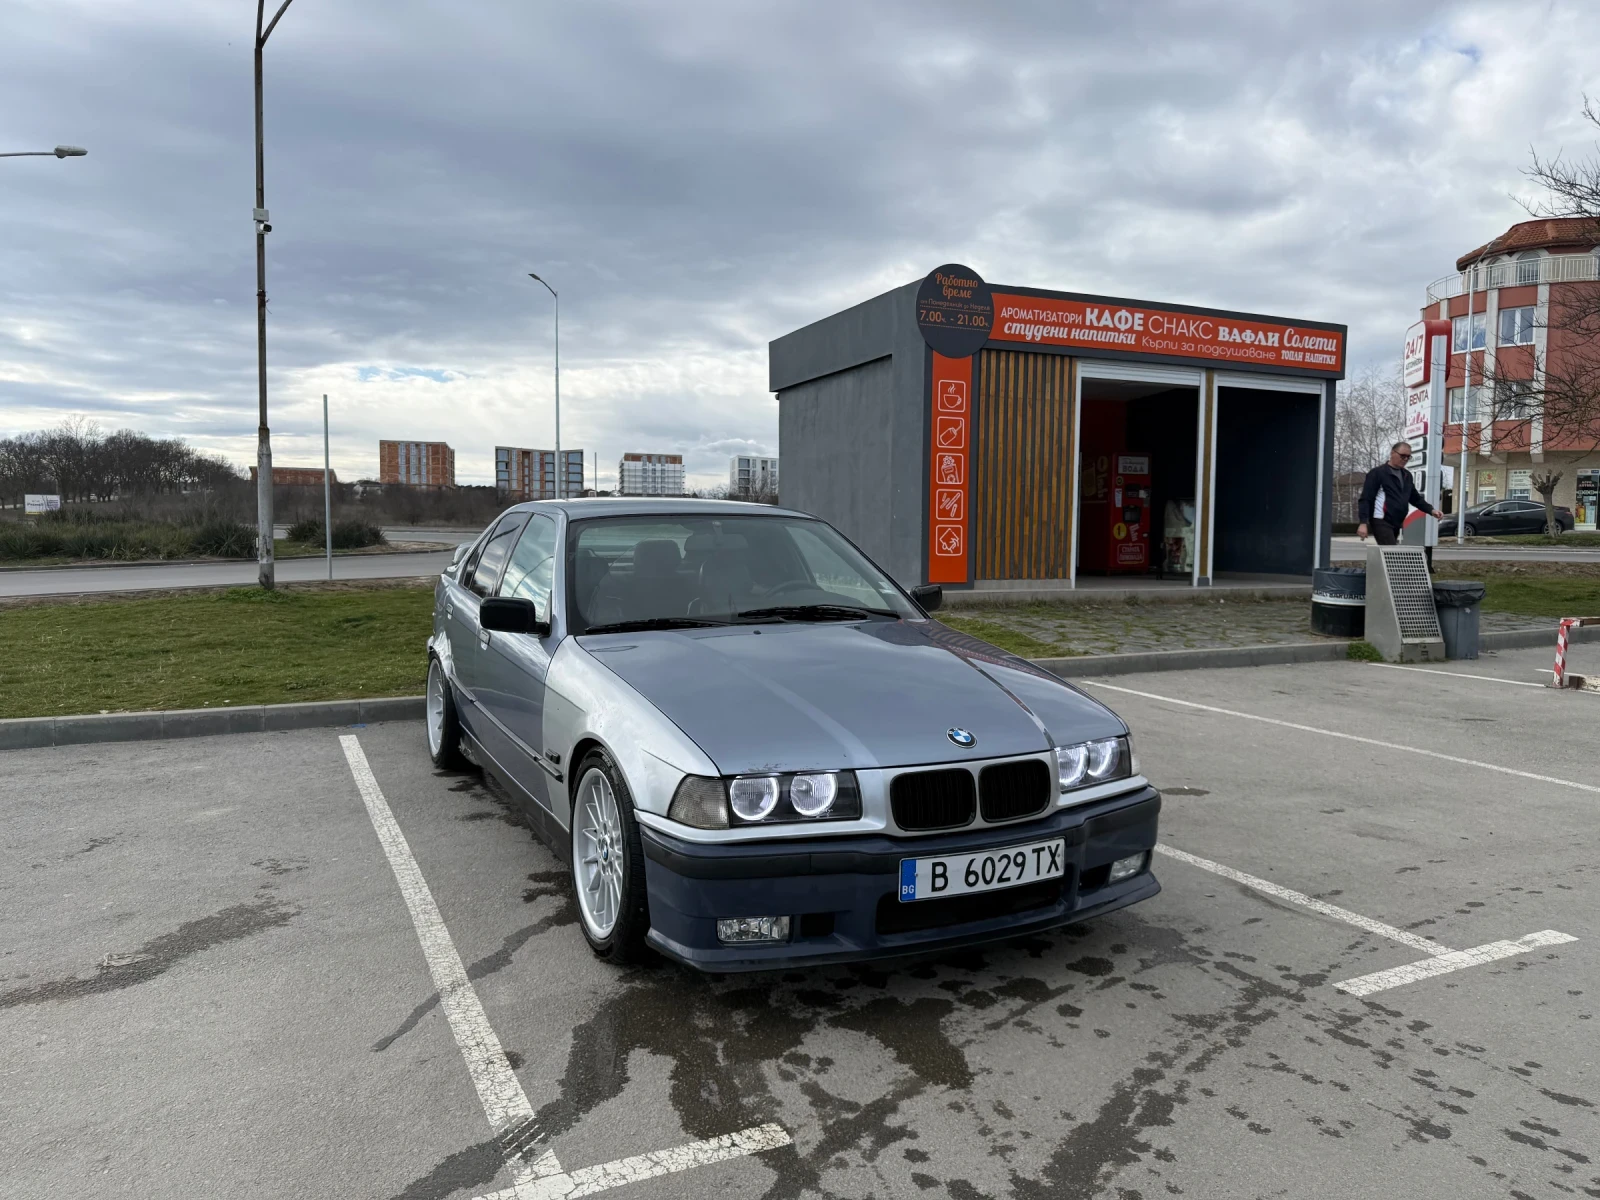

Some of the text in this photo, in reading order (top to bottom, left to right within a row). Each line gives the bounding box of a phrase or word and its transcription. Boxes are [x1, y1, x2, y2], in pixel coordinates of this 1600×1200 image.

[935, 273, 978, 288] Работно
[943, 285, 972, 300] време
[928, 298, 963, 308] Понеделник
[1000, 307, 1337, 352] АРОМАТИЗАТОРИ КАФЕ СНАКС ВАФЛИ Солети
[1003, 321, 1336, 365] студени напитки Кърпи за подсушаване ТОПЛИ НАПИТКИ
[1406, 334, 1423, 360] 24/7
[931, 844, 1060, 892] B 6029 TX
[902, 885, 915, 895] BG
